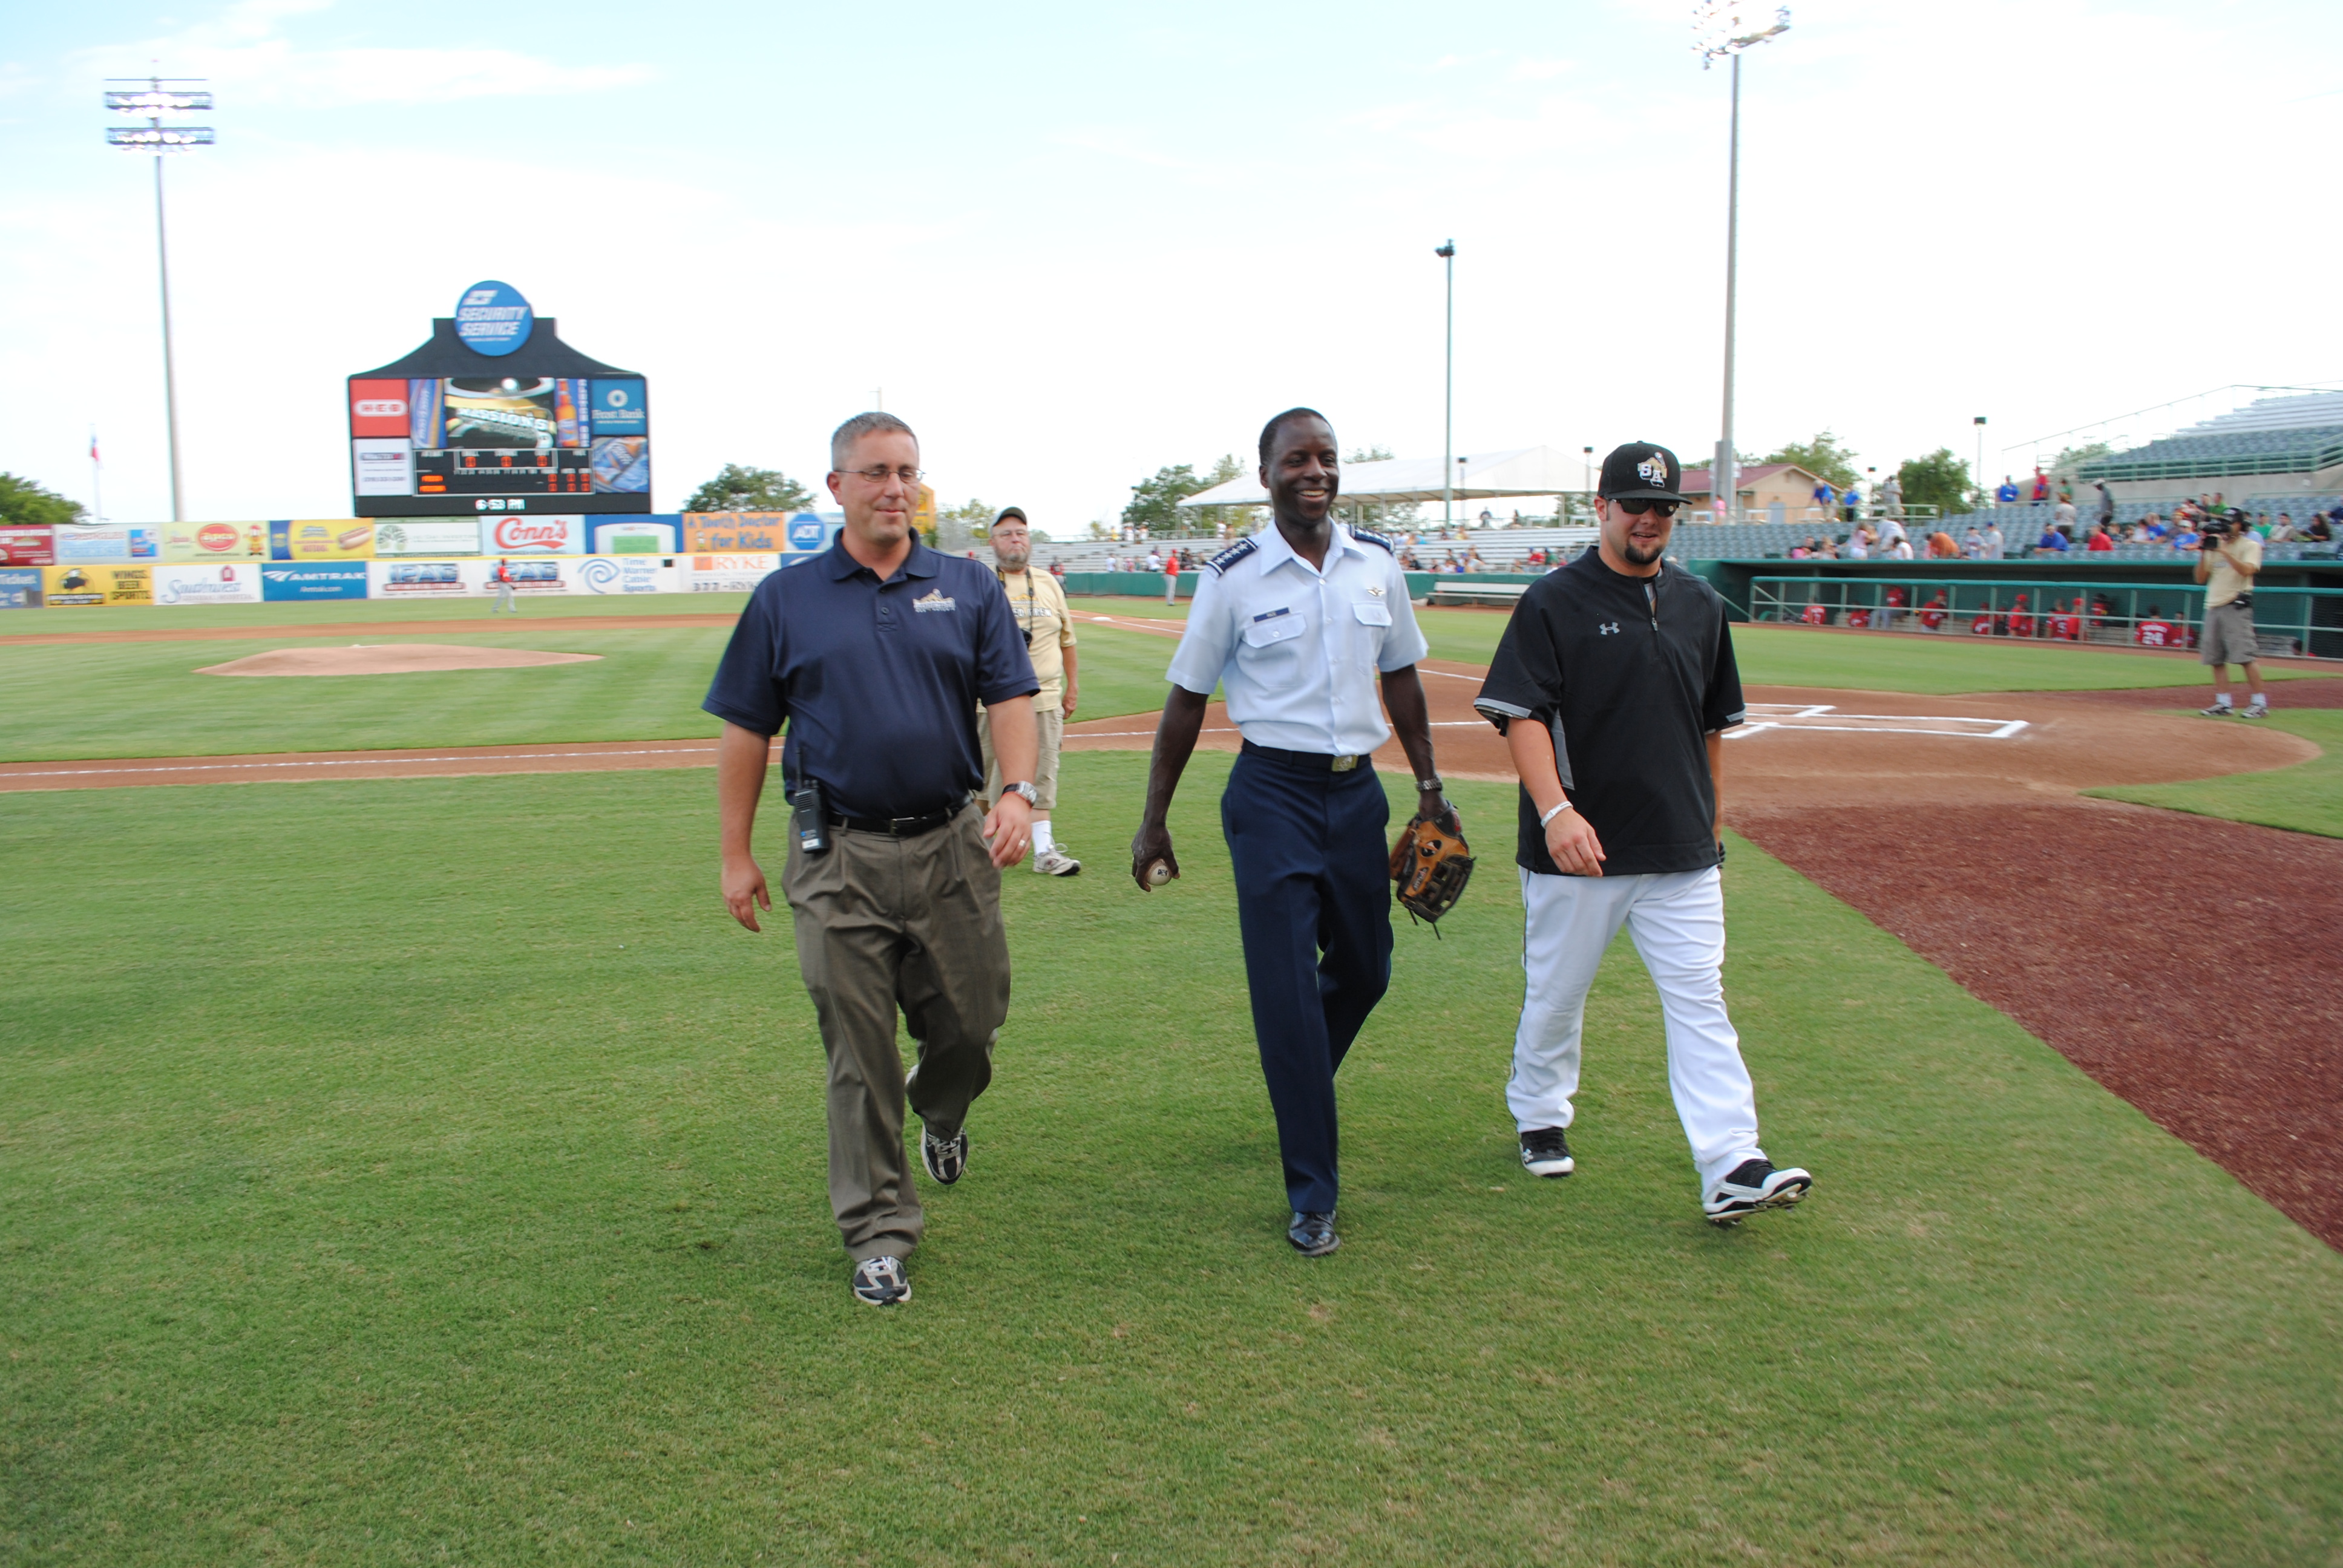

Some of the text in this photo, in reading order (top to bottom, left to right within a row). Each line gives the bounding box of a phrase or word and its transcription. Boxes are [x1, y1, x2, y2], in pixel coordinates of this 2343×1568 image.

[457, 306, 529, 321] SECURITY
[459, 322, 520, 337] SERVICE
[592, 408, 645, 419] Frost Bank
[739, 514, 781, 528] Doctor
[493, 517, 568, 549] Conn's
[793, 524, 821, 539] ADT
[710, 531, 773, 550] for Kids
[288, 572, 368, 581] AMTRAK
[622, 584, 657, 593] Sports
